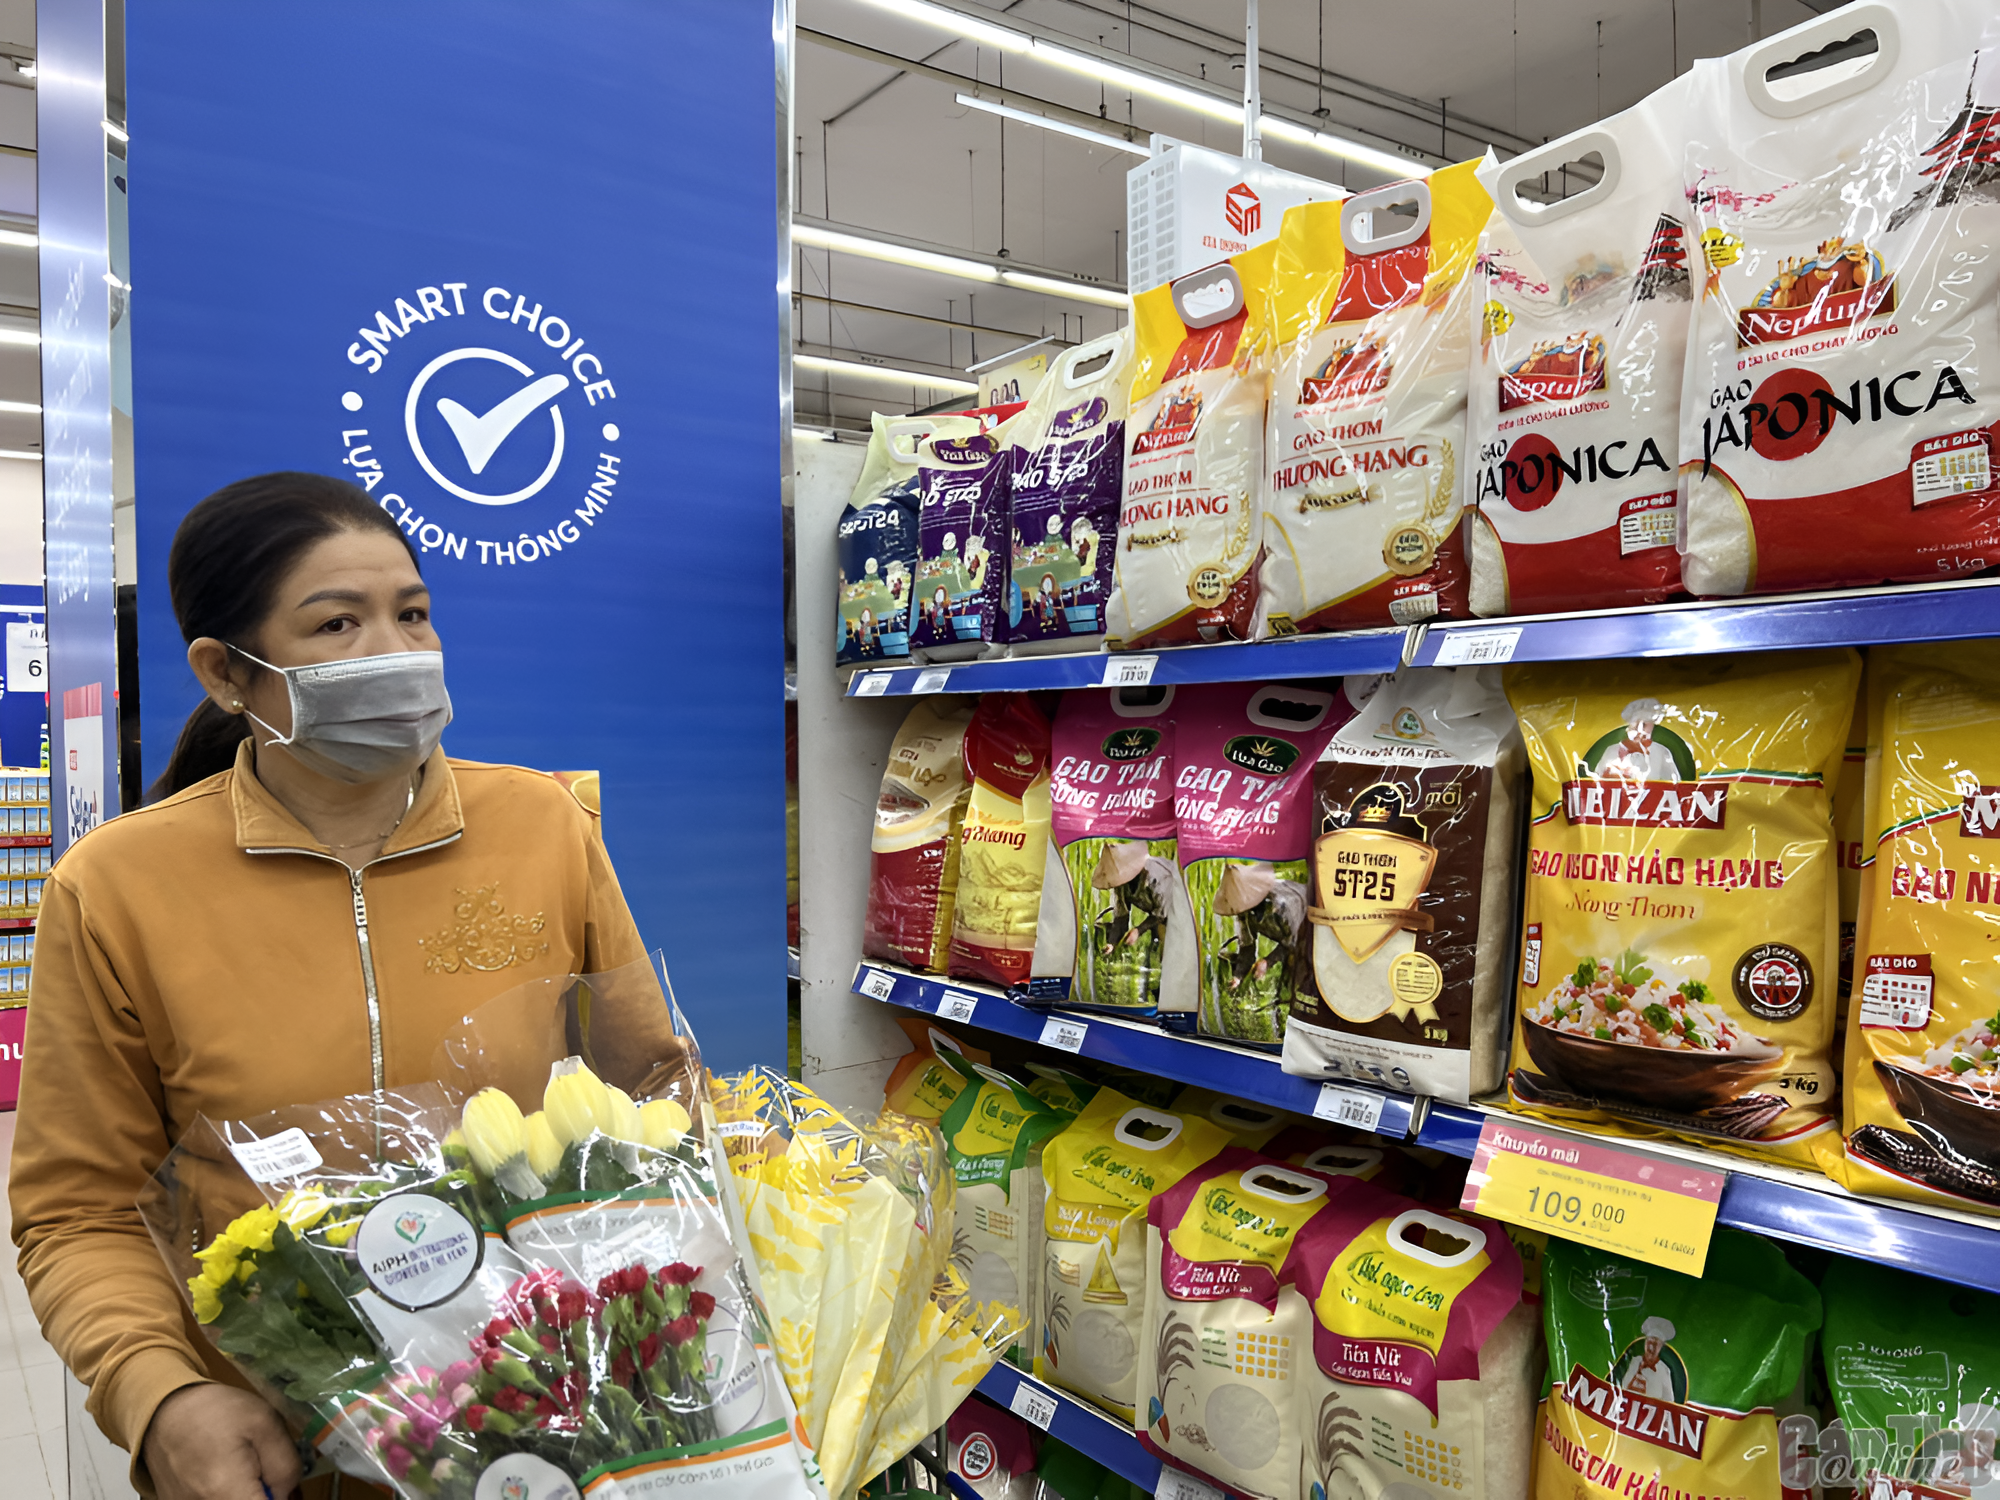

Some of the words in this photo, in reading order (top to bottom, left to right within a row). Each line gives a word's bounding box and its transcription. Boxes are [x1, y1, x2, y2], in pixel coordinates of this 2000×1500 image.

[347, 282, 467, 374] SMART
[482, 287, 617, 406] CHOICE
[1353, 444, 1428, 474] HẠNG
[1701, 366, 1977, 482] JAPONICA
[342, 429, 384, 491] LỰA
[380, 493, 468, 560] CHỌN
[475, 520, 581, 565] THÔNG
[574, 453, 621, 526] MINH
[1476, 437, 1671, 518] JAPONICA
[28, 659, 43, 678] 6
[1334, 868, 1397, 900] ST25
[1564, 853, 1622, 882] NGON
[1626, 848, 1685, 885] HẢO
[1695, 856, 1785, 892] HẠNG
[1571, 1374, 1704, 1454] MEIZAN
